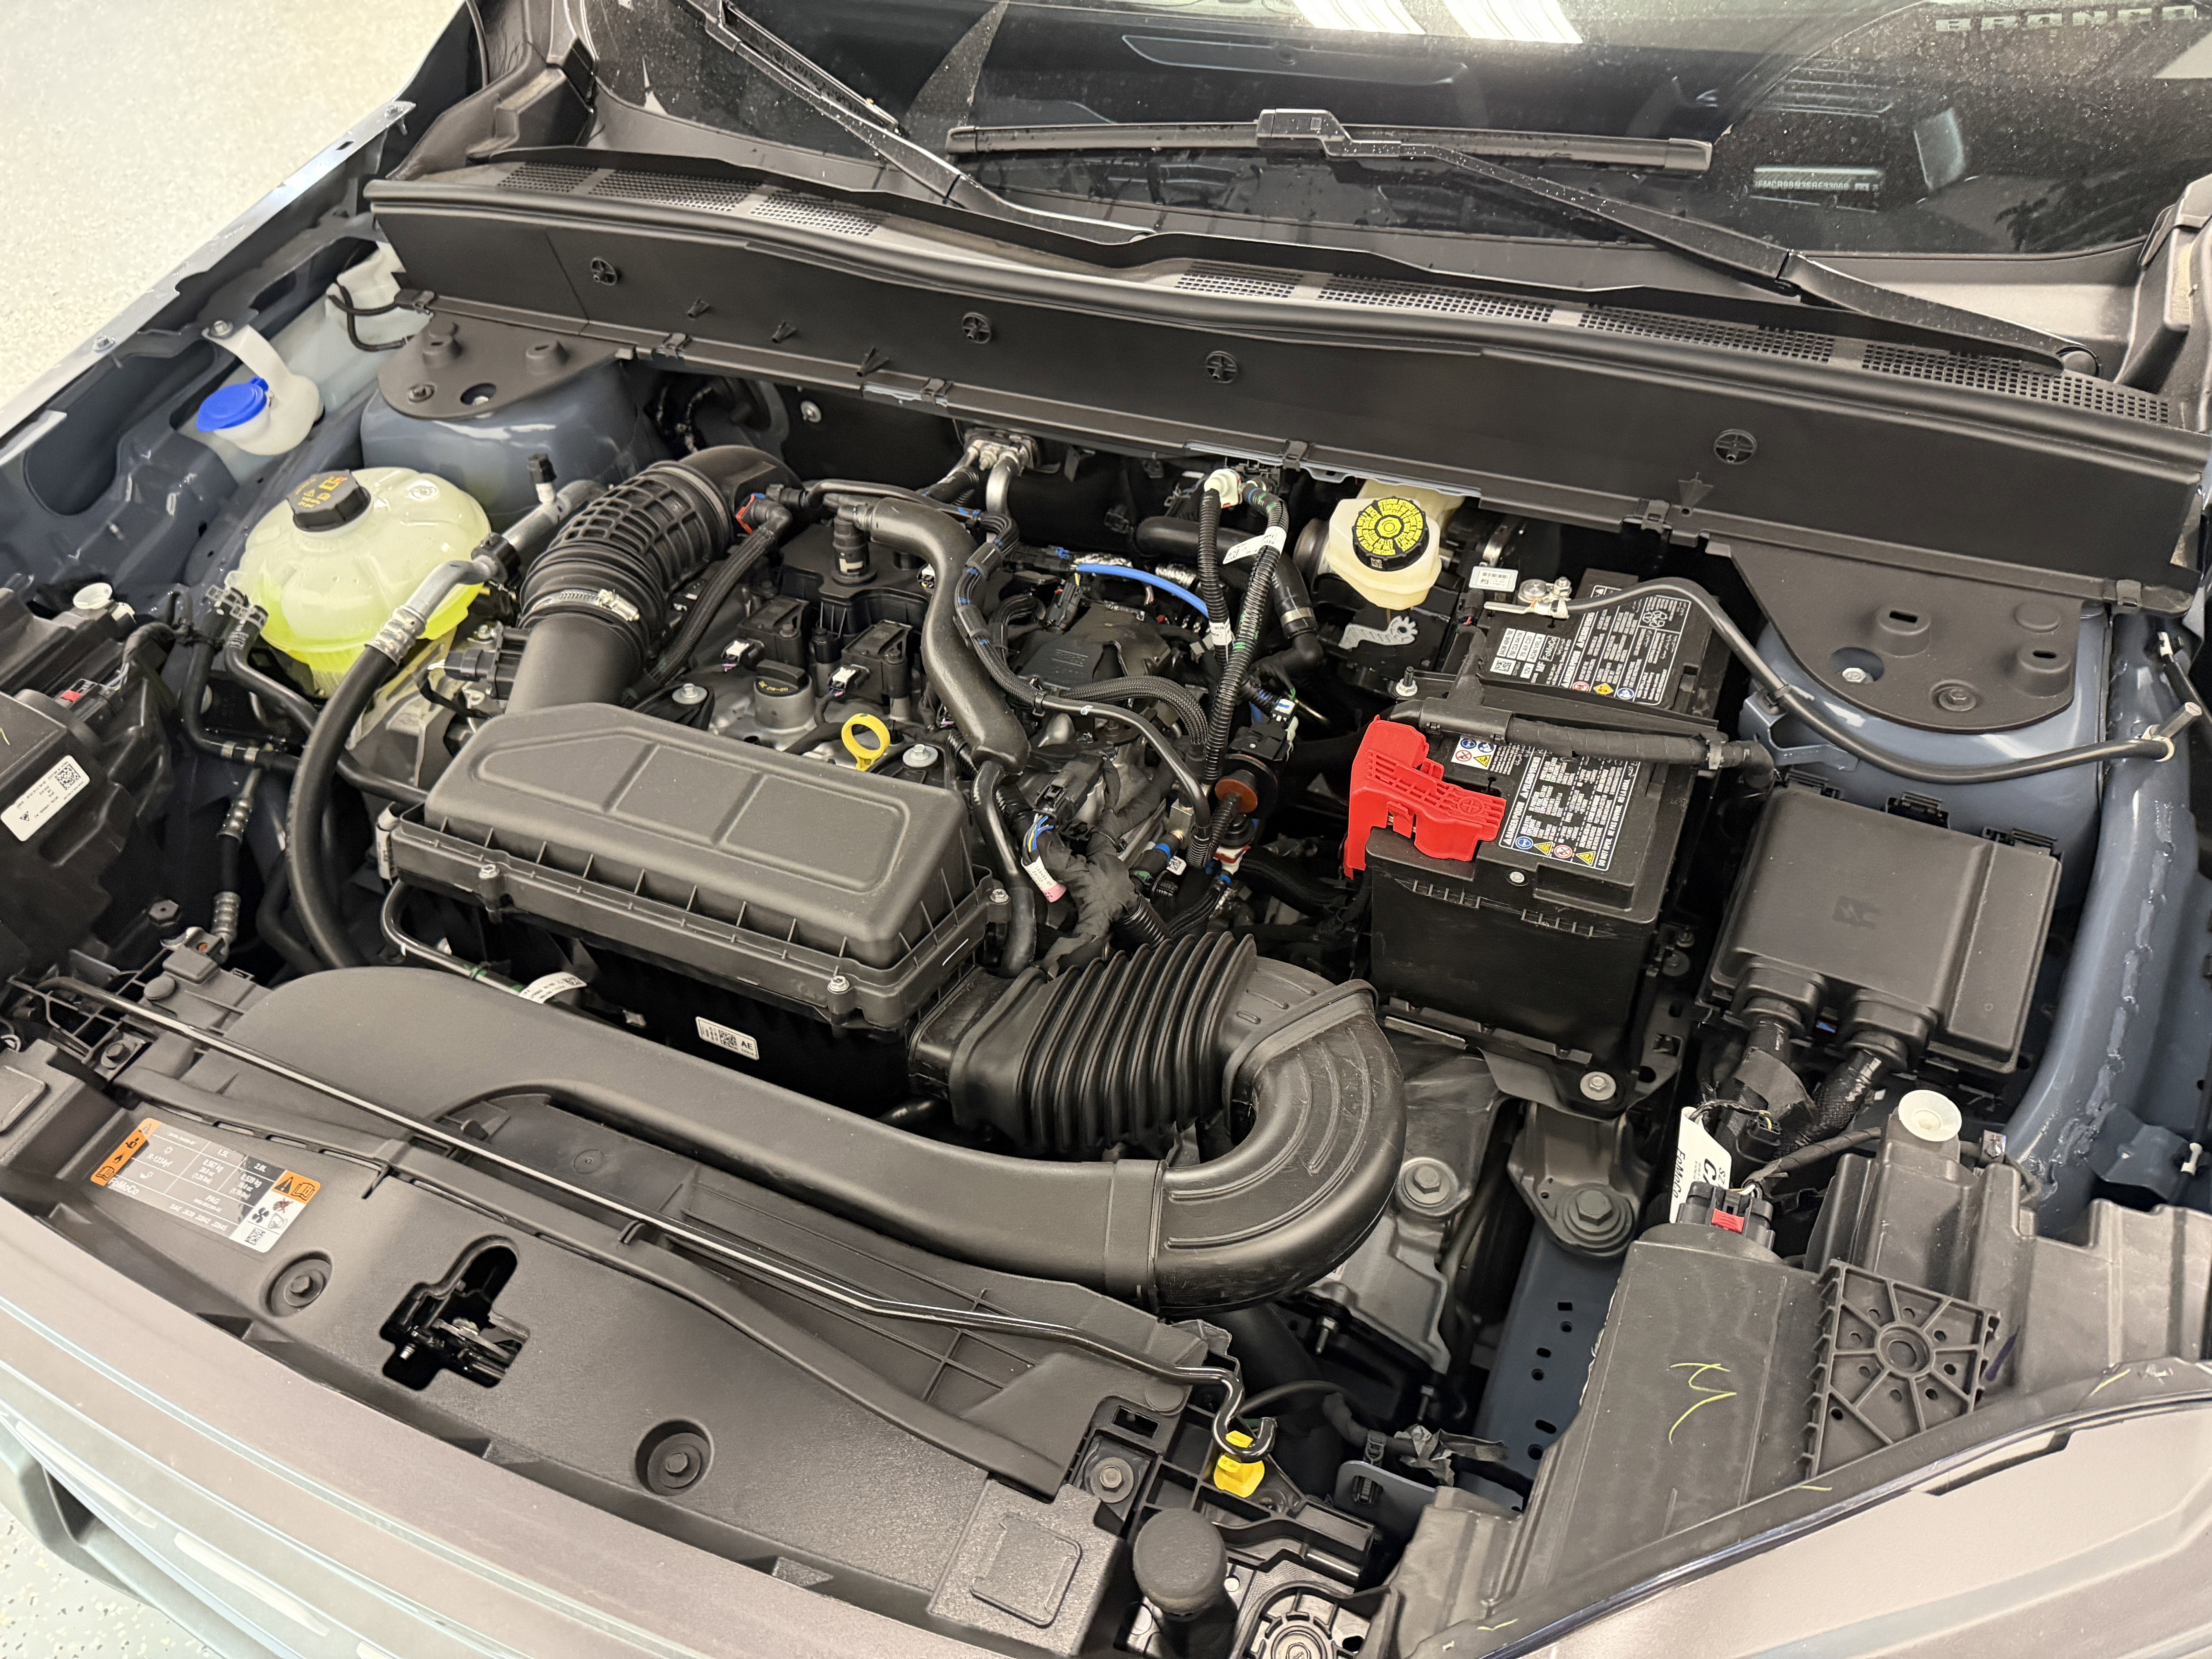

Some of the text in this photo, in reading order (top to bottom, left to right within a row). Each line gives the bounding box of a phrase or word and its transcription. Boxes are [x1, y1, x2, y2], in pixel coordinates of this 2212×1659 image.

[1530, 637, 1542, 660] AGM/VRLA
[1542, 636, 1557, 660] FoMoCo
[1535, 661, 1545, 672] MF
[1522, 757, 1540, 792] PELIGRO/VENENO
[1506, 802, 1524, 838] DANGER/POISON
[1609, 821, 1617, 830] PAS
[1600, 850, 1608, 859] NOT
[741, 1041, 753, 1050] AE
[217, 1149, 229, 1158] 1.5L
[147, 1153, 173, 1167] R-1234yf
[215, 1164, 224, 1173] kg
[254, 1163, 266, 1172] 2.0L
[1673, 1148, 1685, 1198] FoMoCo
[108, 1177, 139, 1195] FoMoCo
[253, 1179, 262, 1188] kg
[205, 1195, 220, 1204] PAG
[169, 1204, 182, 1212] SAE
